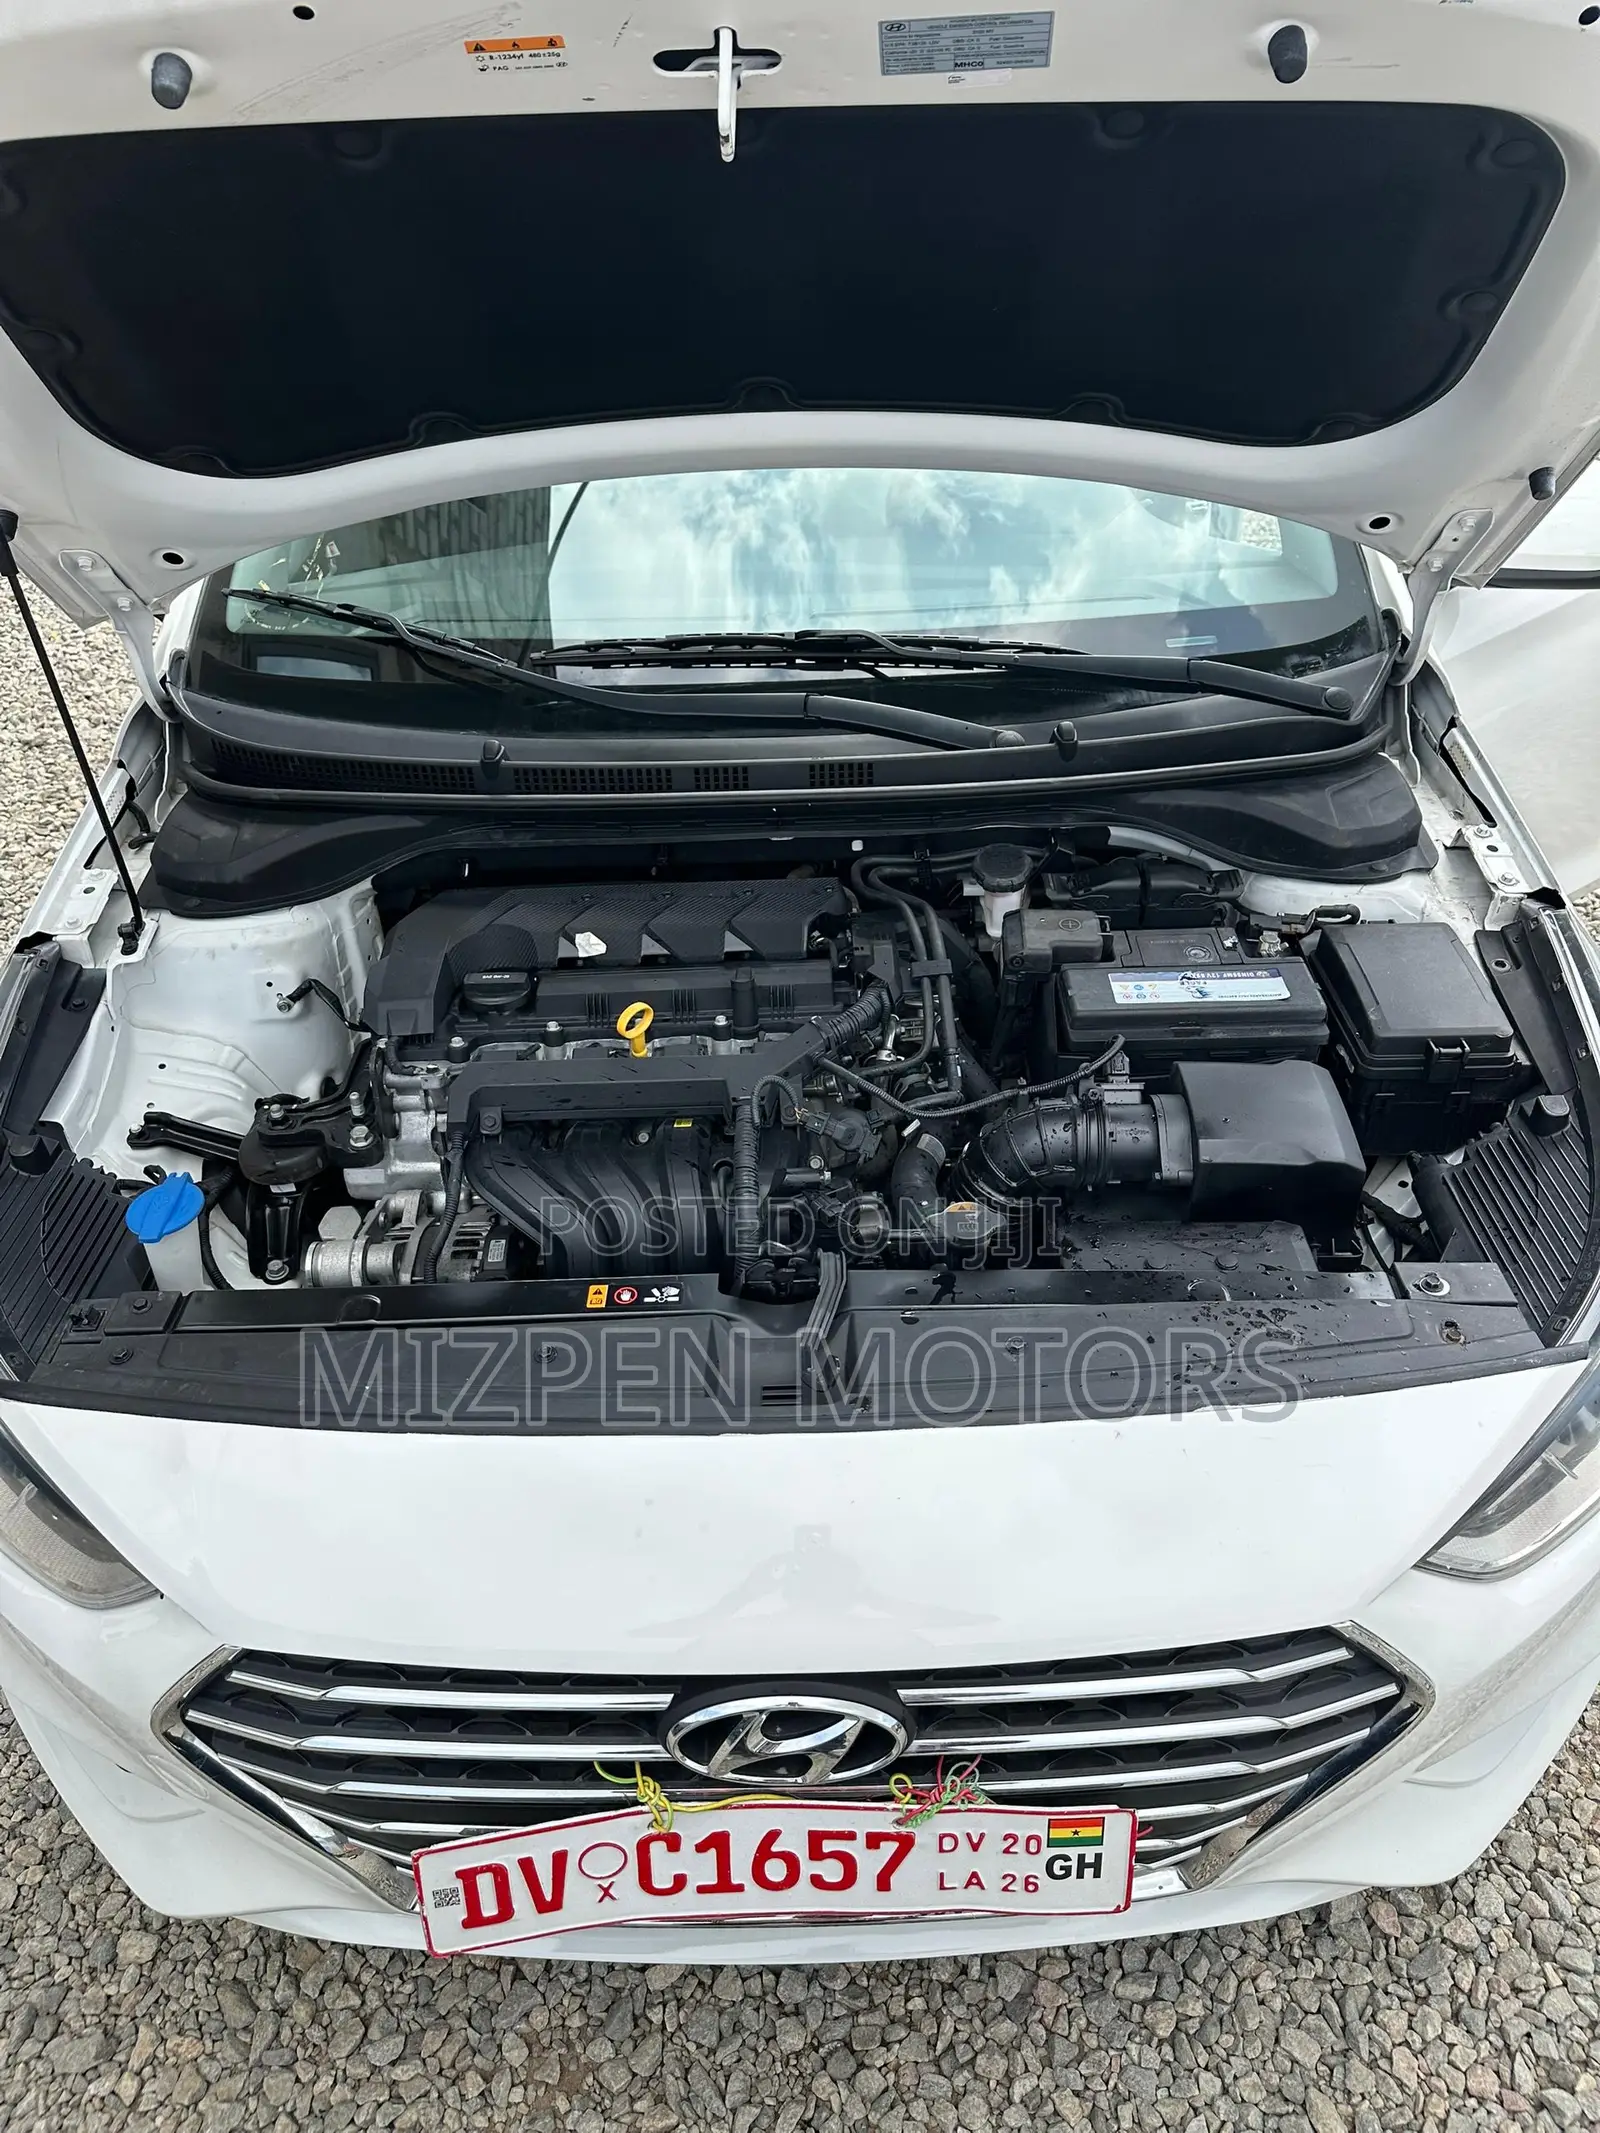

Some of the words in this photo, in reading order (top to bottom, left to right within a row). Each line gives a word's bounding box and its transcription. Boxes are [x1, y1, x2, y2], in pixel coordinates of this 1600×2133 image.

[937, 1832, 983, 1855] DV
[1002, 1833, 1043, 1856] 20
[1045, 1853, 1103, 1880] GH
[454, 1848, 569, 1930] DV
[635, 1829, 916, 1896] C1657
[939, 1871, 986, 1893] LA
[1001, 1872, 1041, 1894] 26
